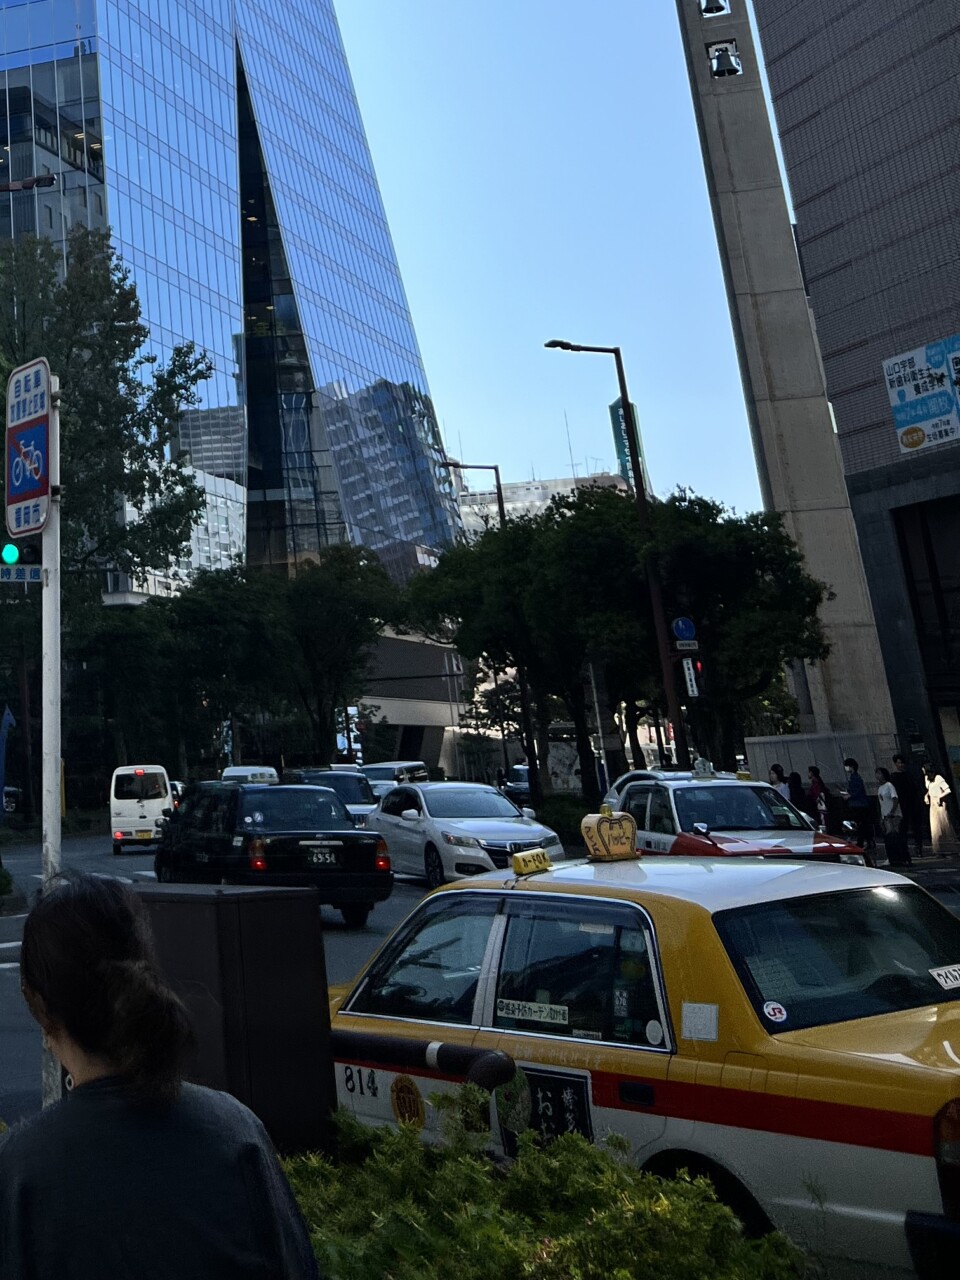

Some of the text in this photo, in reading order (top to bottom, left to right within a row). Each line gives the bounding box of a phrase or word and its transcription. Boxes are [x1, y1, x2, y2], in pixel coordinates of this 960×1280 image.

[15, 369, 41, 399] 自転車
[1, 568, 40, 580] 時差信
[767, 1007, 784, 1017] JR
[344, 1065, 378, 1098] 814
